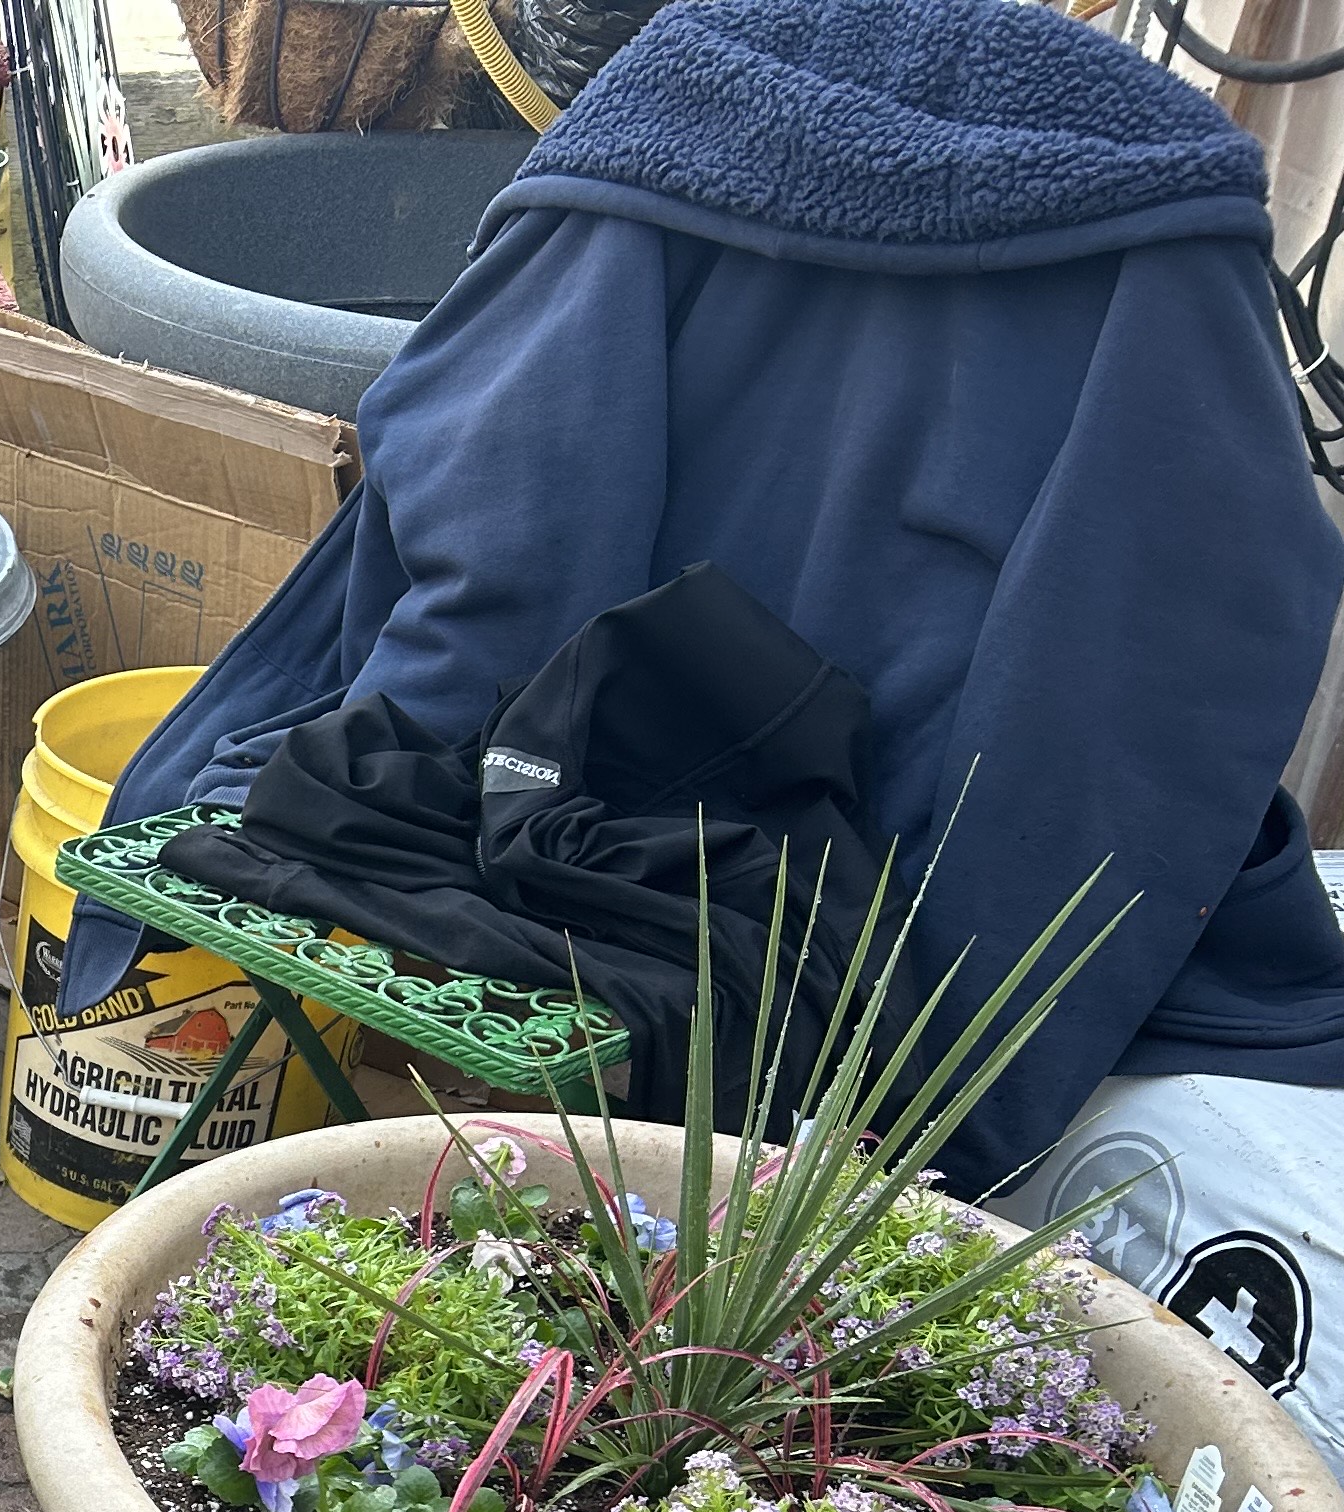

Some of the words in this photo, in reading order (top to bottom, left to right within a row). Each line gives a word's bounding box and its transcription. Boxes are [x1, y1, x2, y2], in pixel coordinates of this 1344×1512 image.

[64, 561, 97, 671] CORPORATION
[224, 1000, 242, 1010] Part
[25, 1068, 161, 1146] HYDRAULIC
[175, 1119, 256, 1150] LUID
